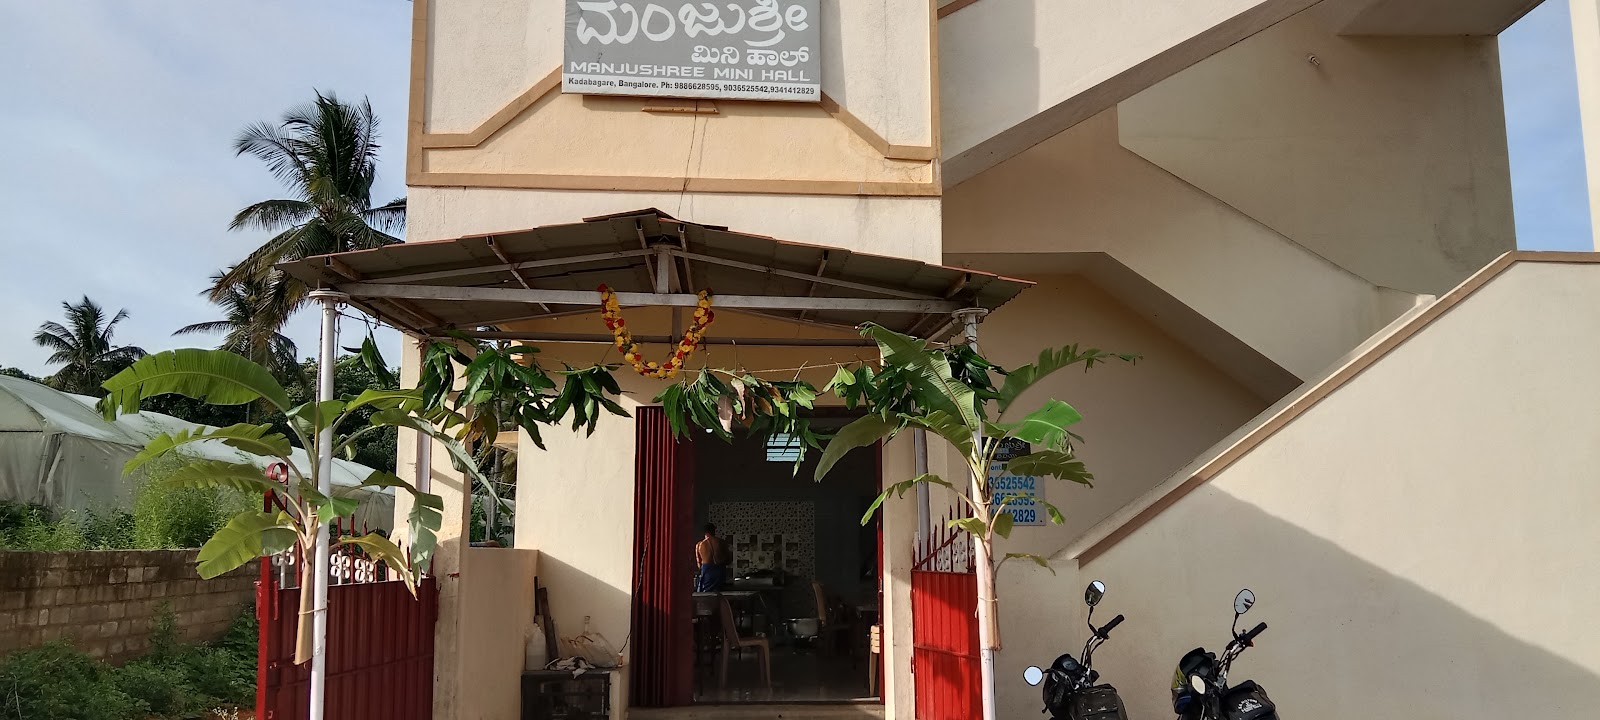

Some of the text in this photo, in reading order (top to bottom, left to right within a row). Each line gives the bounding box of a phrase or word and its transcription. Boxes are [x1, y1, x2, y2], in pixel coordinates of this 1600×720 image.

[576, 0, 809, 47] ಮಂಜುಶ್ರೀ
[691, 45, 810, 67] ಮಿನಿ ಹಾಲ್
[570, 61, 811, 82] MANJUSHREE MINI HALL
[568, 77, 617, 88] Kadabagare,
[660, 81, 673, 89] Ph:
